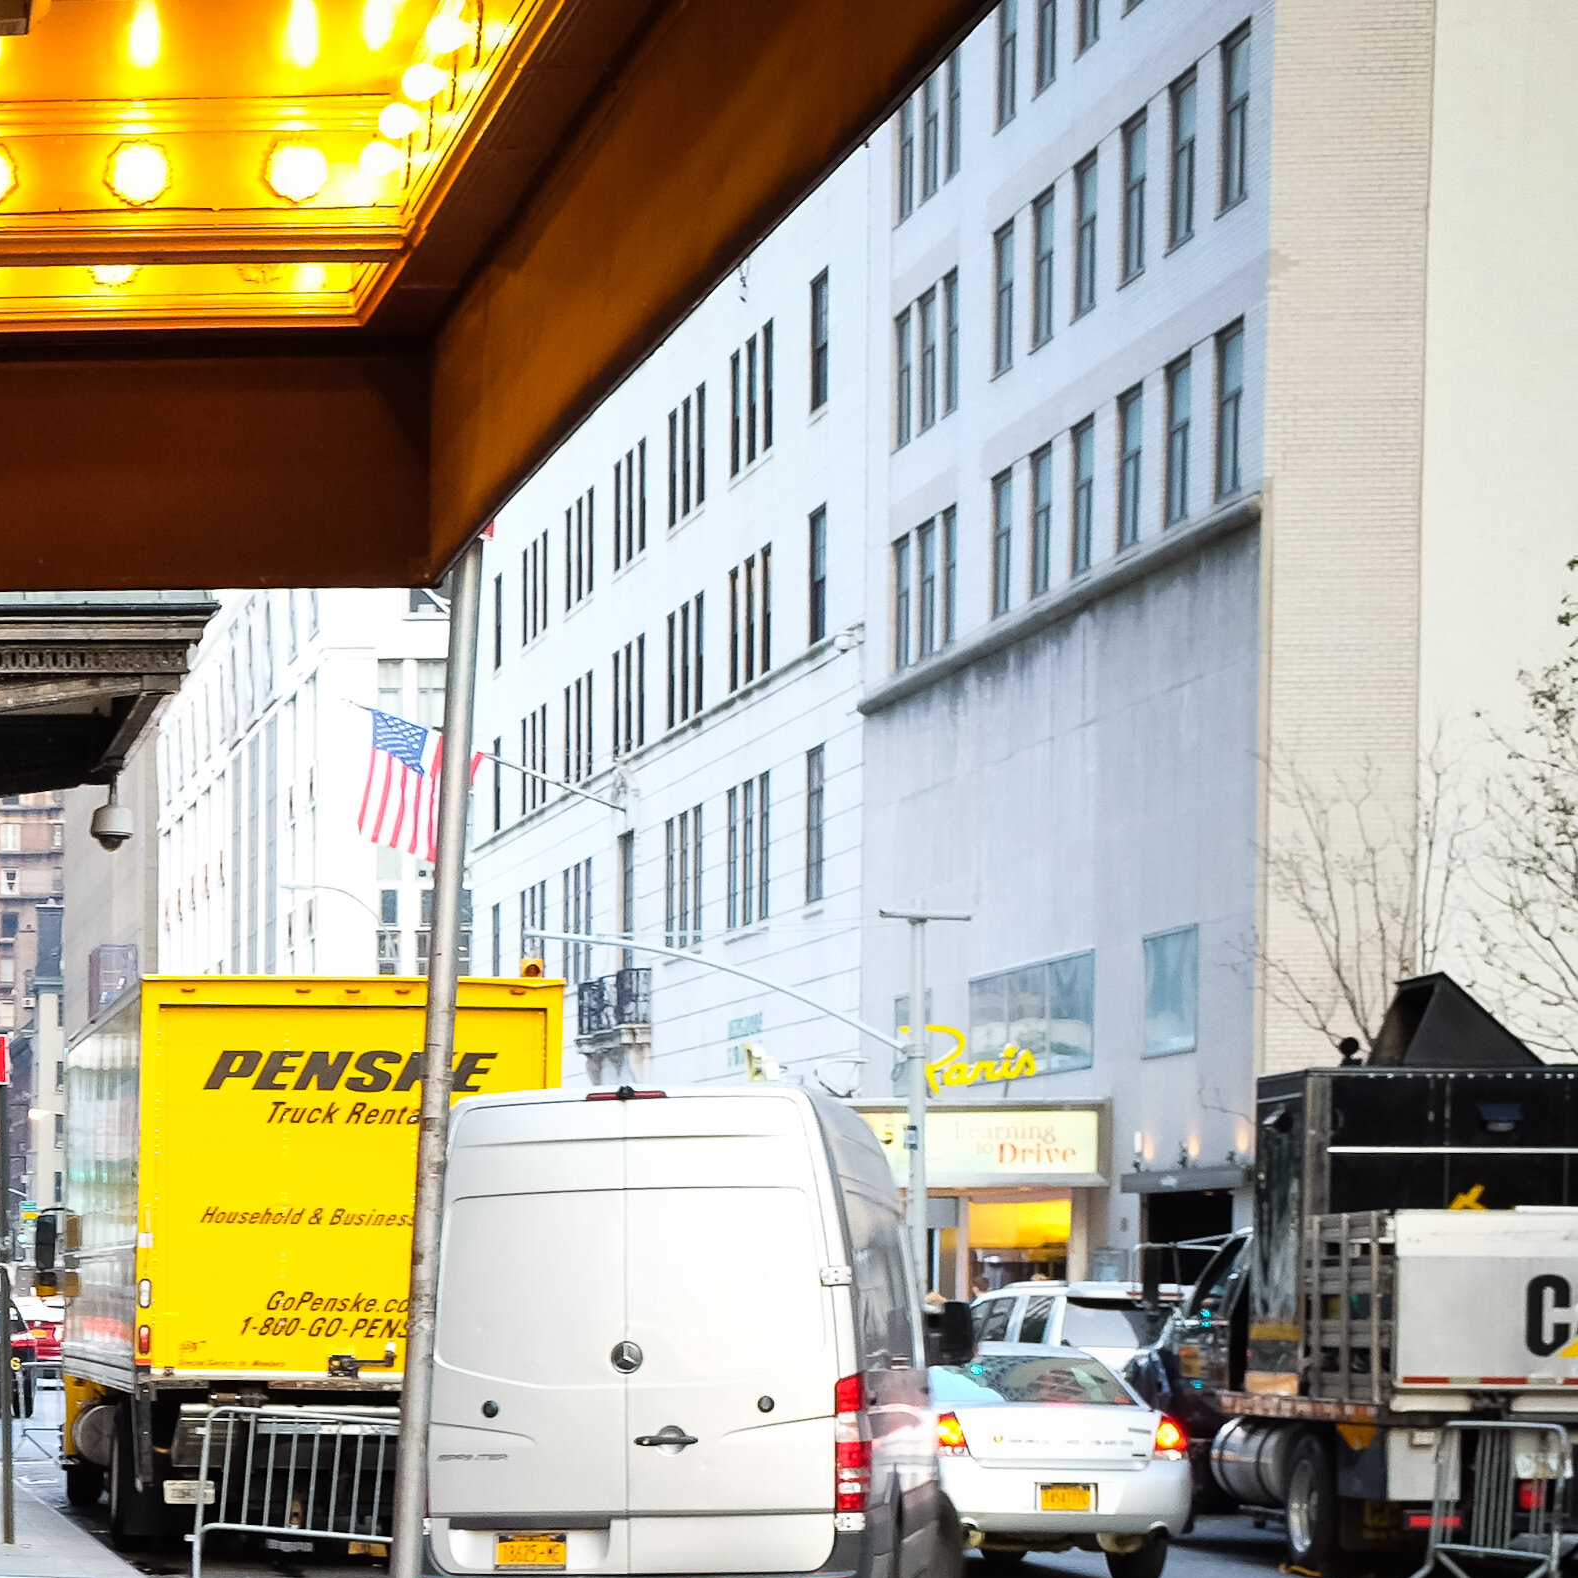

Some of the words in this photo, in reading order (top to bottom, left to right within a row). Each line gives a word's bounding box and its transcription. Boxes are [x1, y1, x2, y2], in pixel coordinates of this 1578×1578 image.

[899, 1024, 1037, 1094] Paris
[266, 1101, 341, 1125] Truck
[345, 1101, 422, 1126] Renta
[954, 1121, 1057, 1144] Learning
[997, 1142, 1078, 1165] Drive
[200, 1206, 306, 1225] Household
[308, 1207, 325, 1226] &
[265, 1290, 409, 1313] GoPenske.co
[240, 1316, 408, 1339] 1-800-GO-PENS
